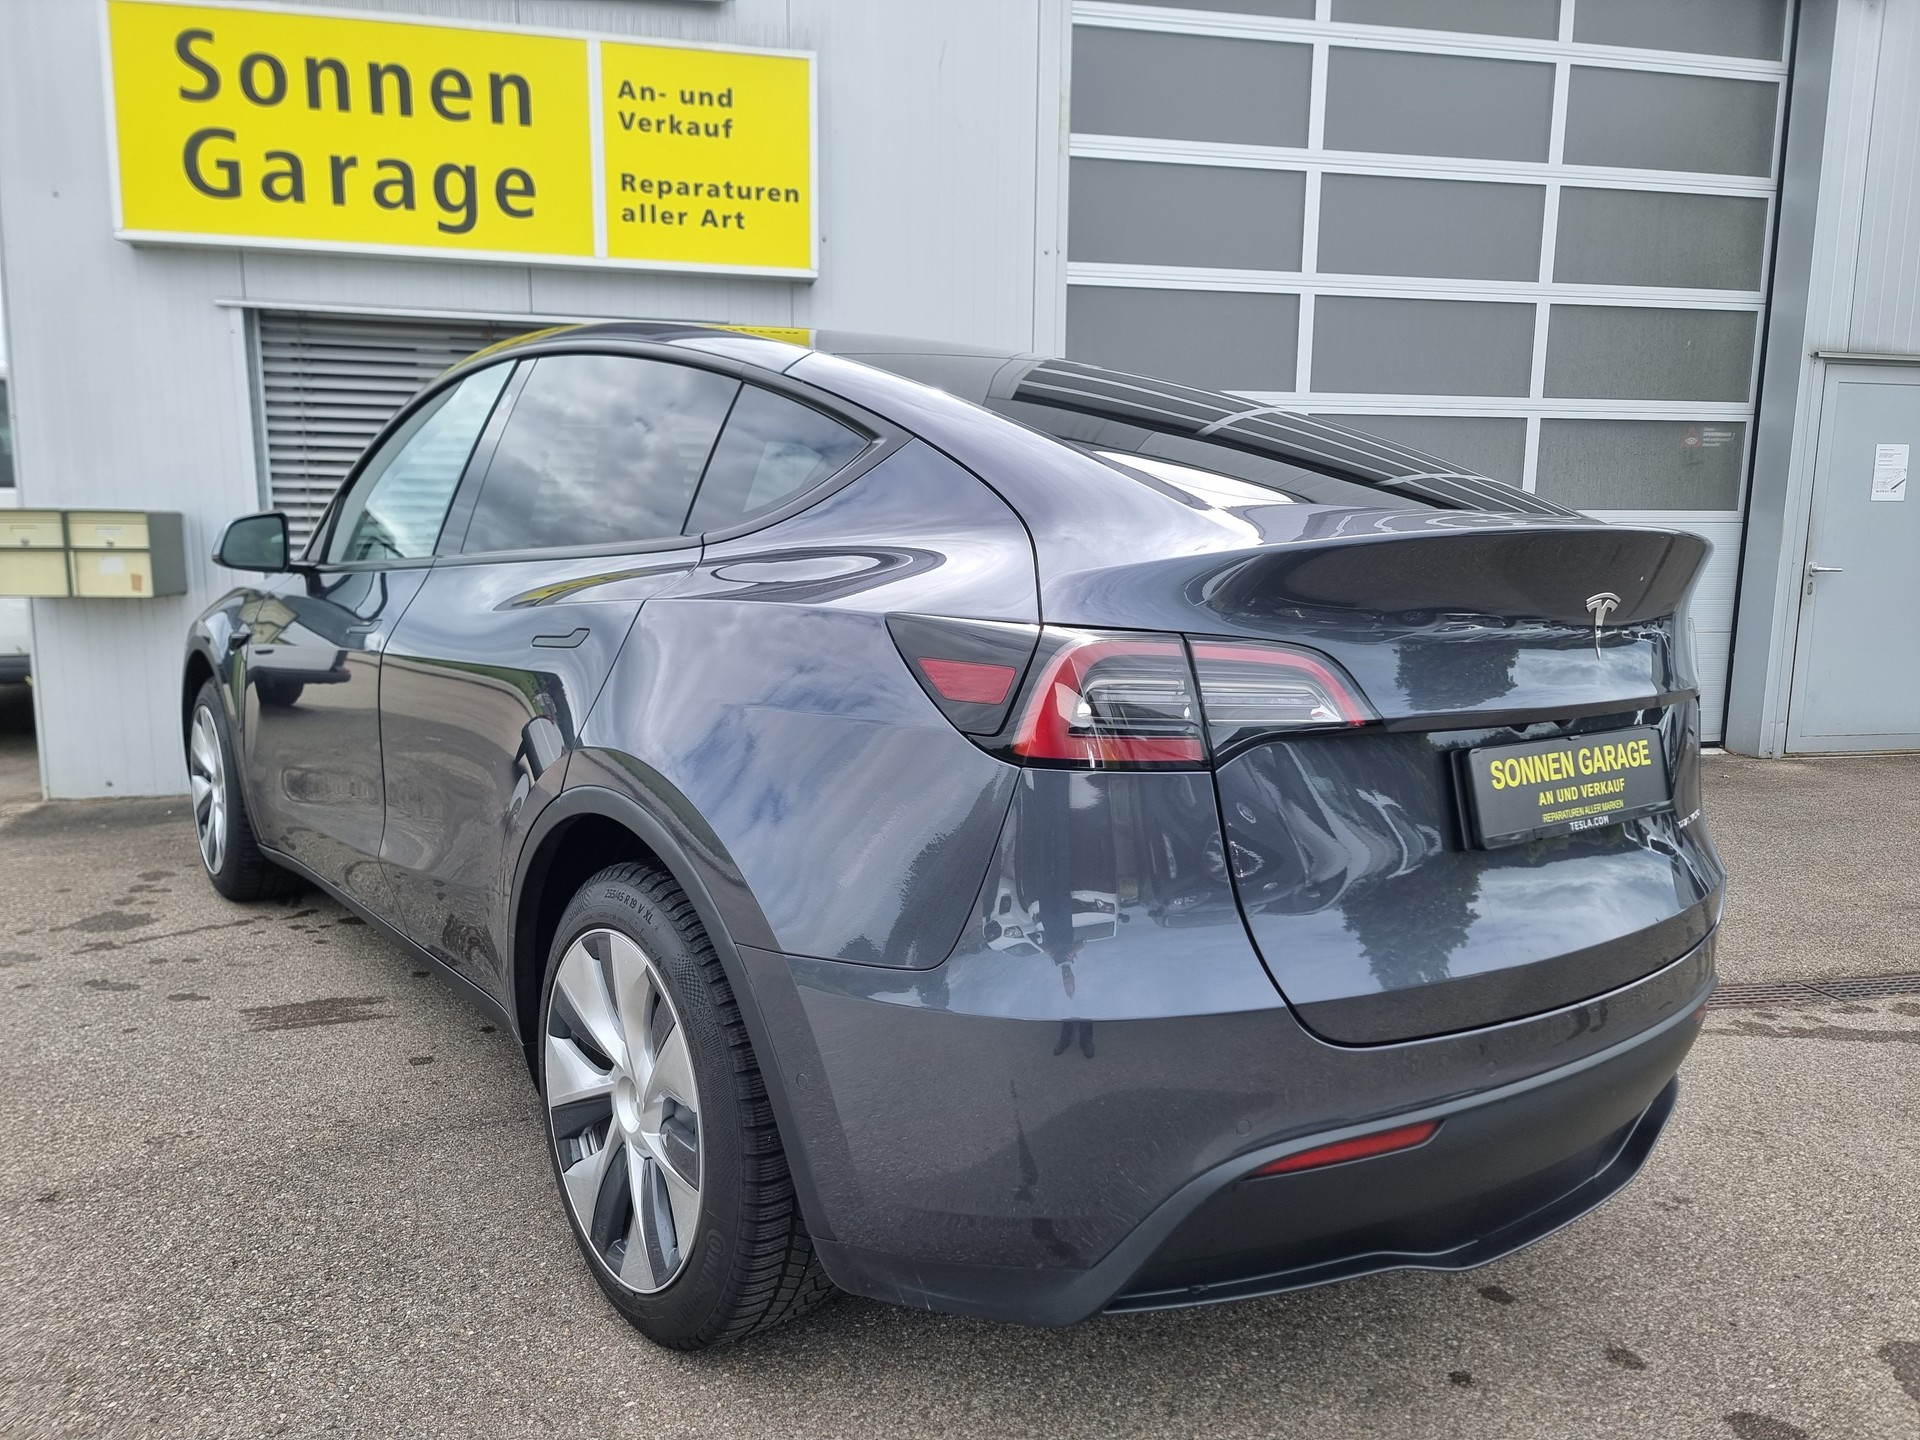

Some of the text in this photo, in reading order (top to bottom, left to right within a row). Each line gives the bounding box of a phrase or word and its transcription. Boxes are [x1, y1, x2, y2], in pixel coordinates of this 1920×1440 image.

[174, 27, 533, 128] Sonnen
[618, 79, 734, 109] An- und
[618, 111, 734, 139] Verkauf
[182, 127, 537, 235] Garage
[620, 172, 800, 204] Reparaturen
[621, 203, 746, 230] aller Art
[1490, 739, 1651, 789] SONNEN GARAGE
[1538, 778, 1626, 807] AN UND VERKAUF
[1542, 799, 1625, 823] REPARATUREN ALLER MARKEN
[1569, 815, 1609, 831] TESLA.COM
[637, 903, 645, 914] V
[643, 909, 653, 925] XL
